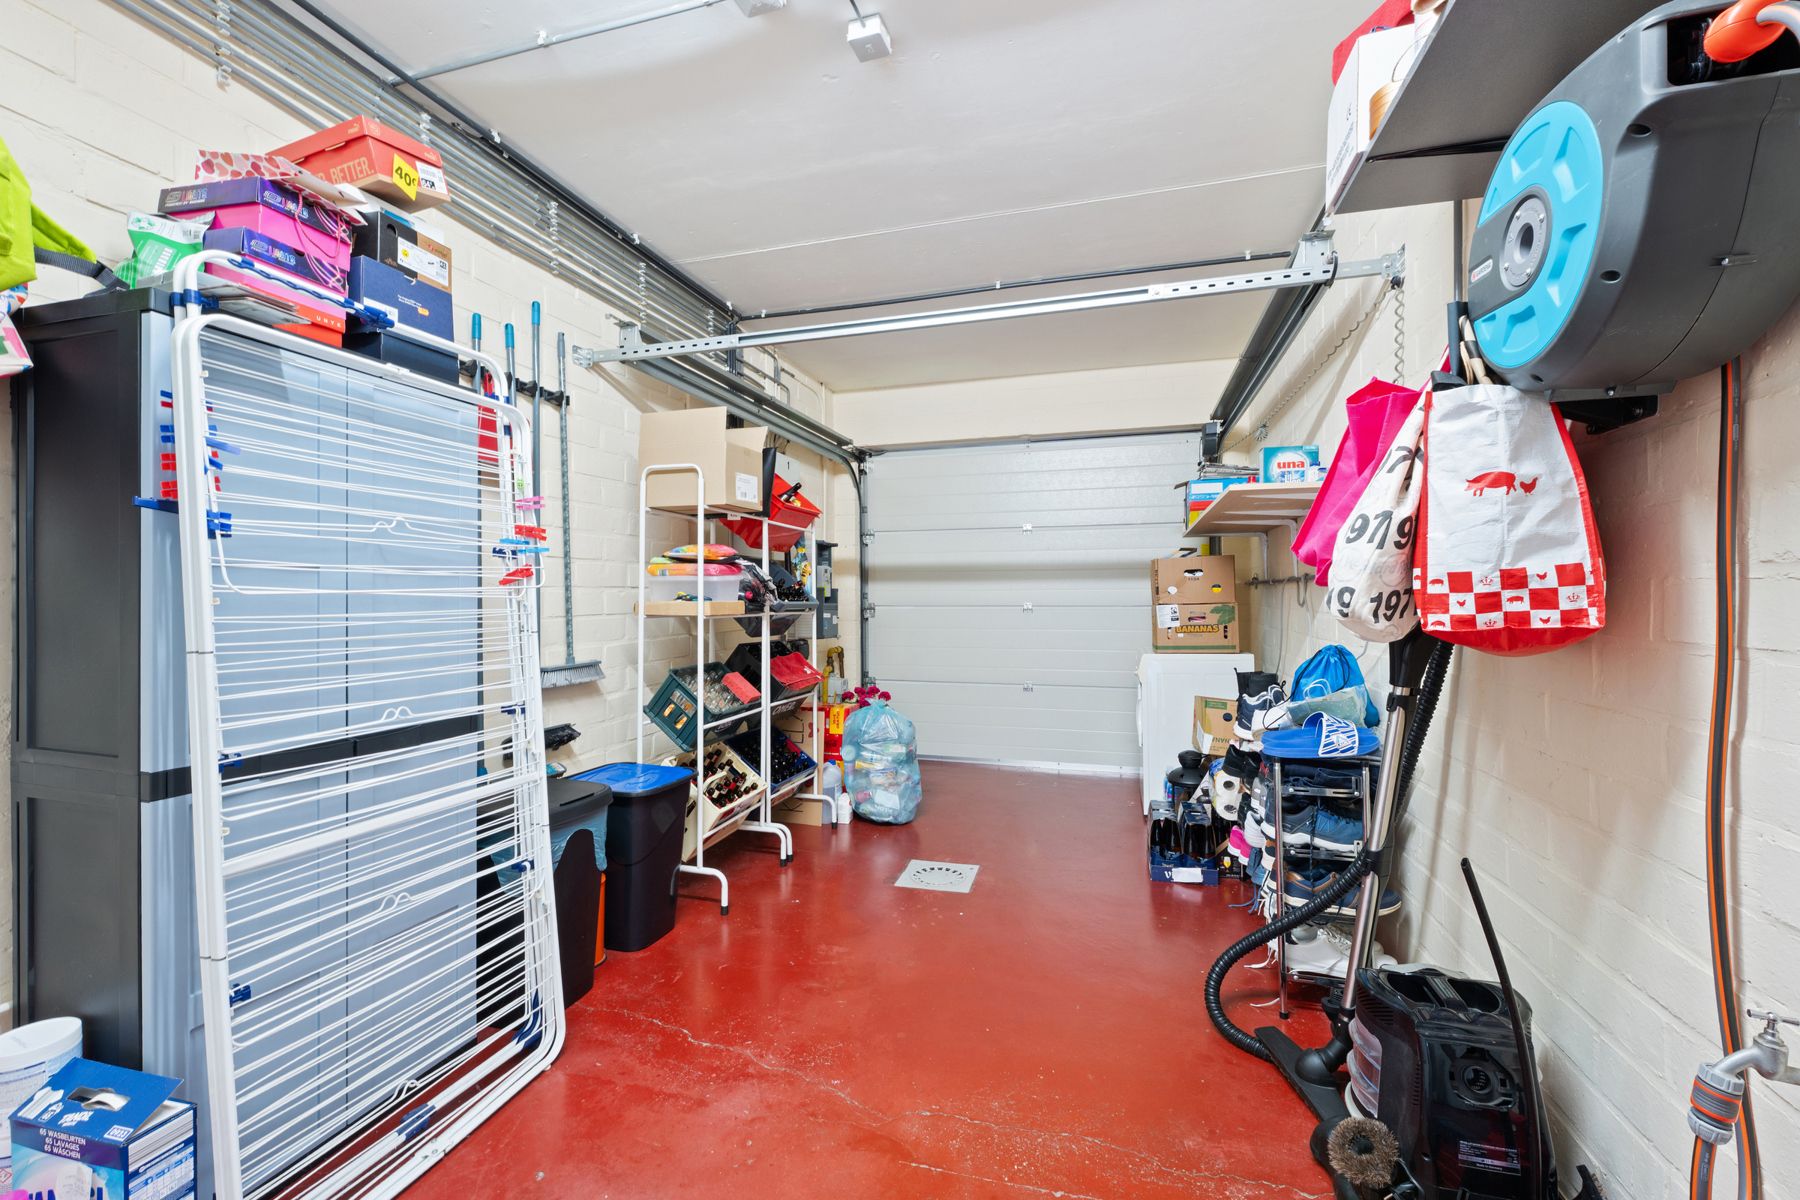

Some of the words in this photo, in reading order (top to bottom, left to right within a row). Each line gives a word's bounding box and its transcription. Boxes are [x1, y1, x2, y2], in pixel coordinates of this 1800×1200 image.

[330, 156, 375, 184] BETTER.
[1276, 460, 1305, 469] una
[1175, 624, 1219, 634] BANANAS
[39, 1128, 47, 1136] 65
[47, 1129, 86, 1146] WASBEURTEN
[44, 1144, 52, 1152] 65
[45, 1136, 53, 1145] 65
[53, 1139, 80, 1151] LAVAGES
